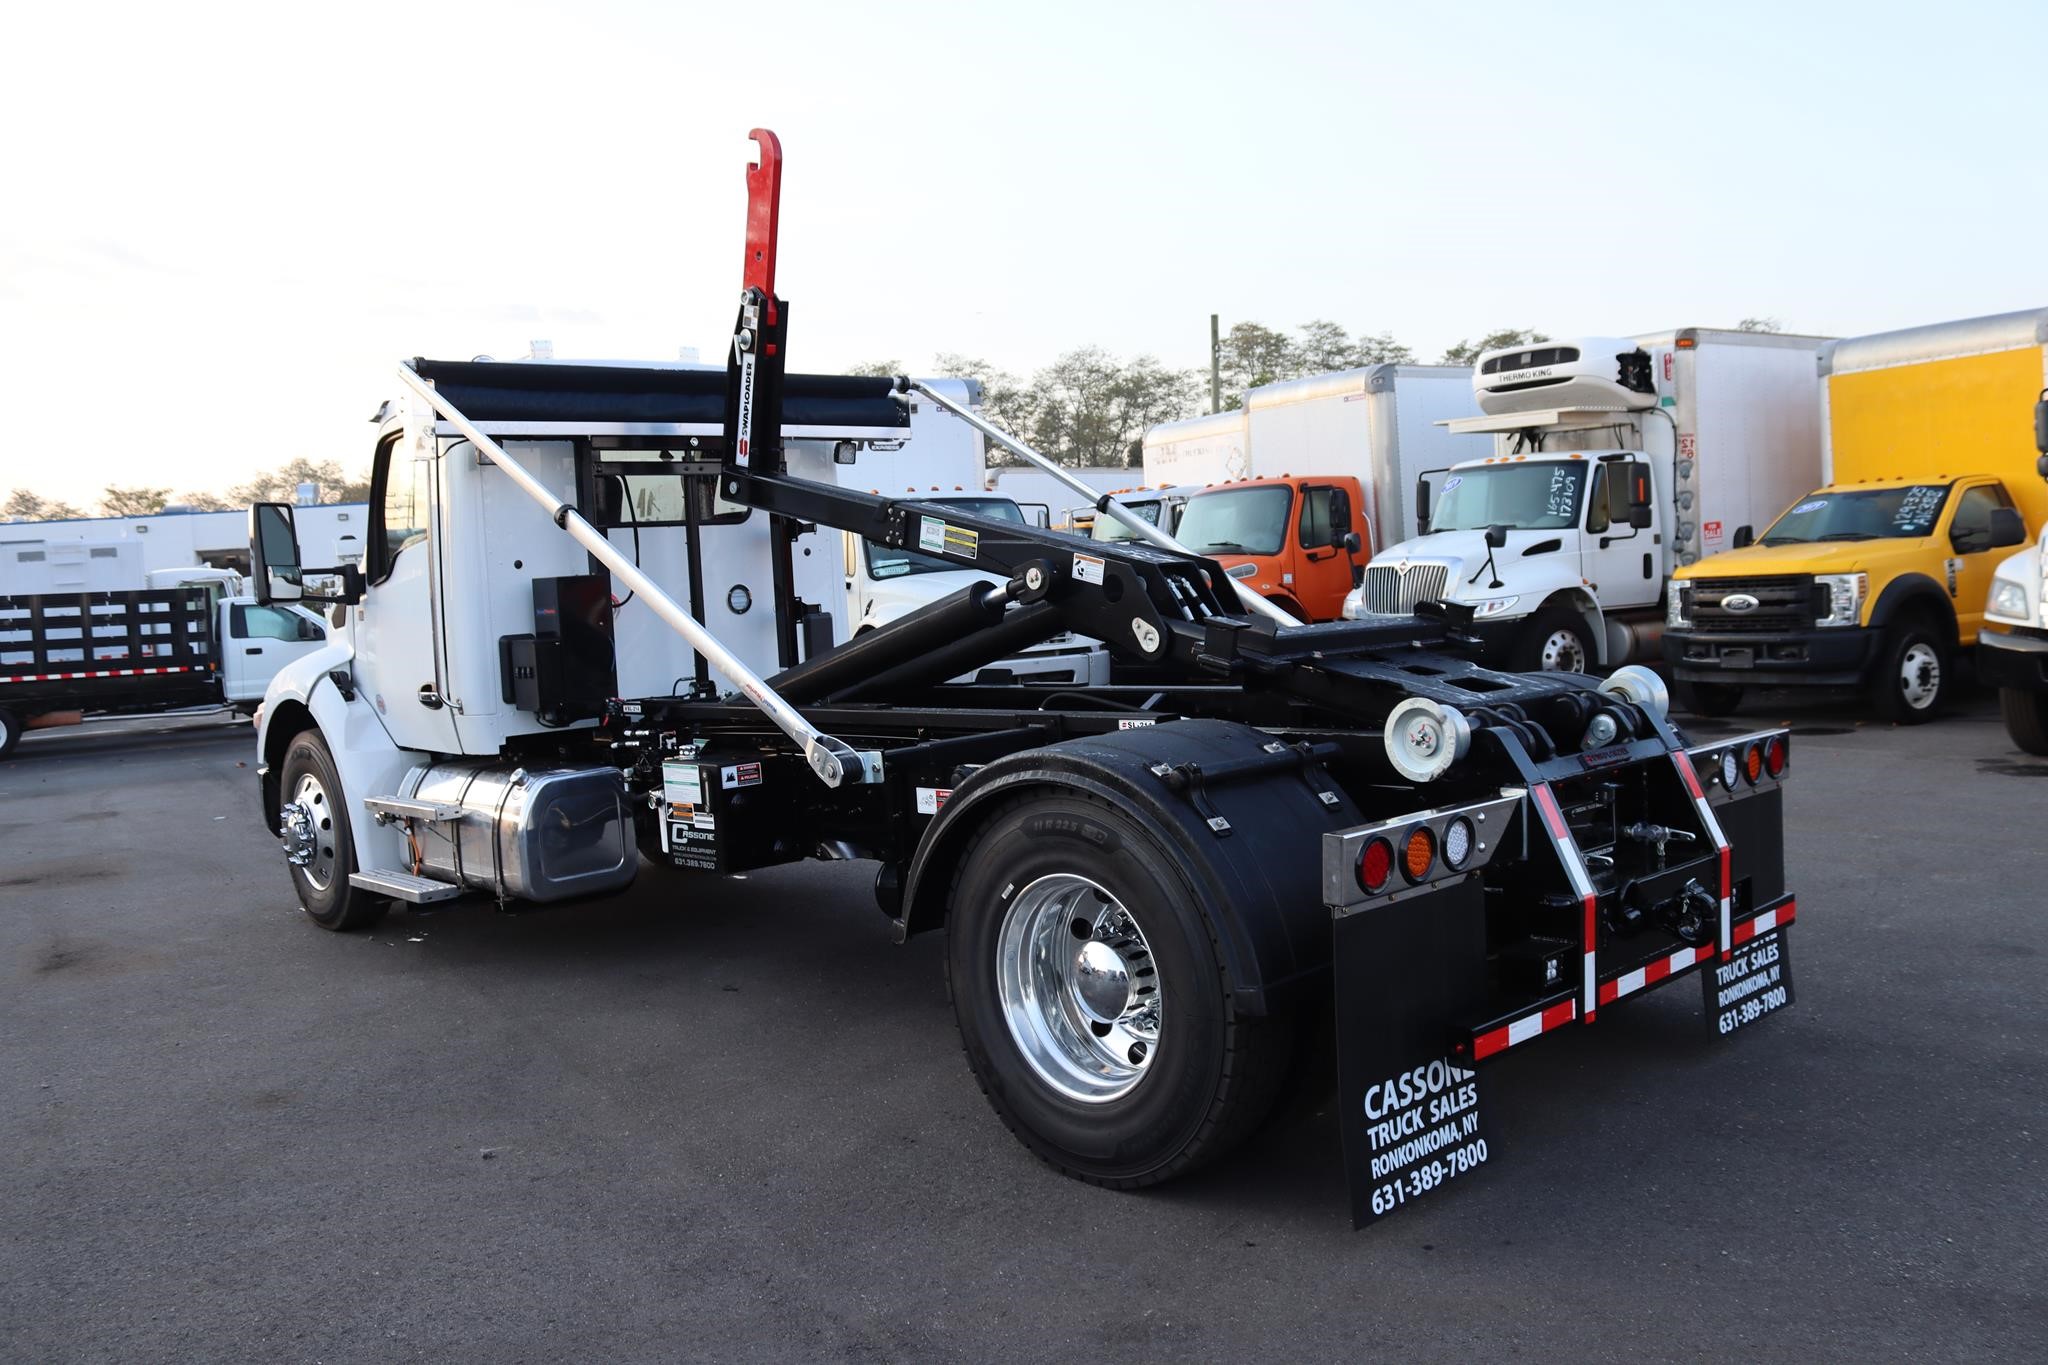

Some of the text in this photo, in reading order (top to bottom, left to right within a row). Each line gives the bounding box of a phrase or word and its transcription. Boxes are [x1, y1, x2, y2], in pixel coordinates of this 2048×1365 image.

[1499, 367, 1553, 383] THERMO KING
[742, 362, 753, 436] SWAPLOADER
[1559, 476, 1576, 517] 173109
[1705, 528, 1722, 538] SALE
[671, 823, 715, 844] CASSONE
[1716, 956, 1750, 986] TRUCK
[1750, 943, 1779, 971] SALES
[1718, 964, 1781, 1008] RONKONKOMA, NY
[1719, 985, 1787, 1034] 631-389-7800
[1367, 1083, 1478, 1151] TRUCK SALES
[1371, 1111, 1479, 1180] RONKONKOMA, NY
[1372, 1138, 1488, 1215] 631-389-7800
